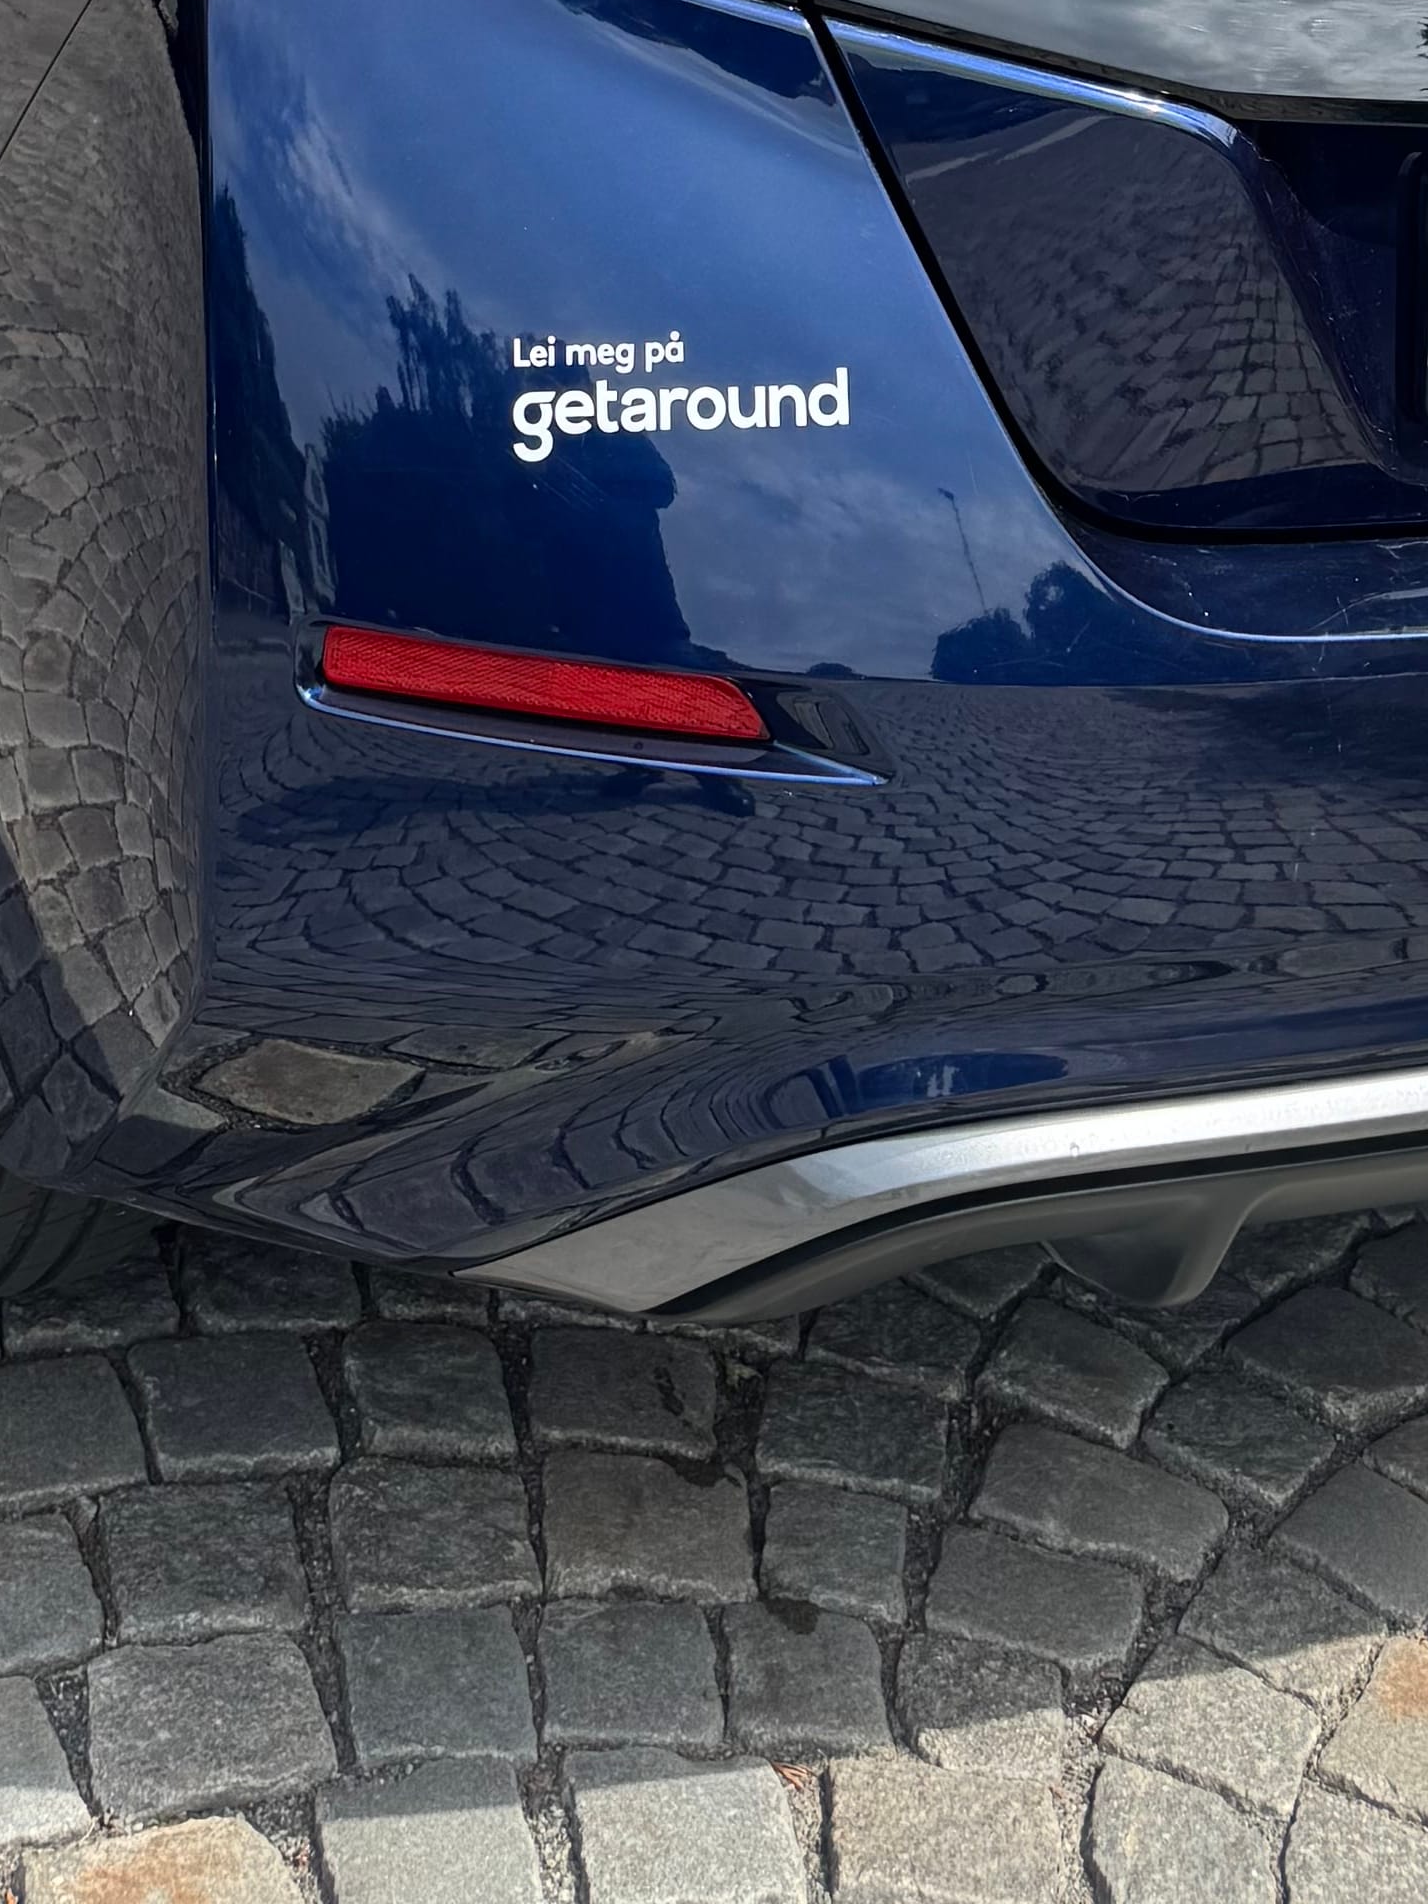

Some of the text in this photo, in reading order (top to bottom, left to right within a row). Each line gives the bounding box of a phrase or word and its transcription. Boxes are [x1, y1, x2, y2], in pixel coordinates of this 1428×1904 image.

[513, 330, 686, 375] Lei meg på
[512, 367, 851, 464] getaround
